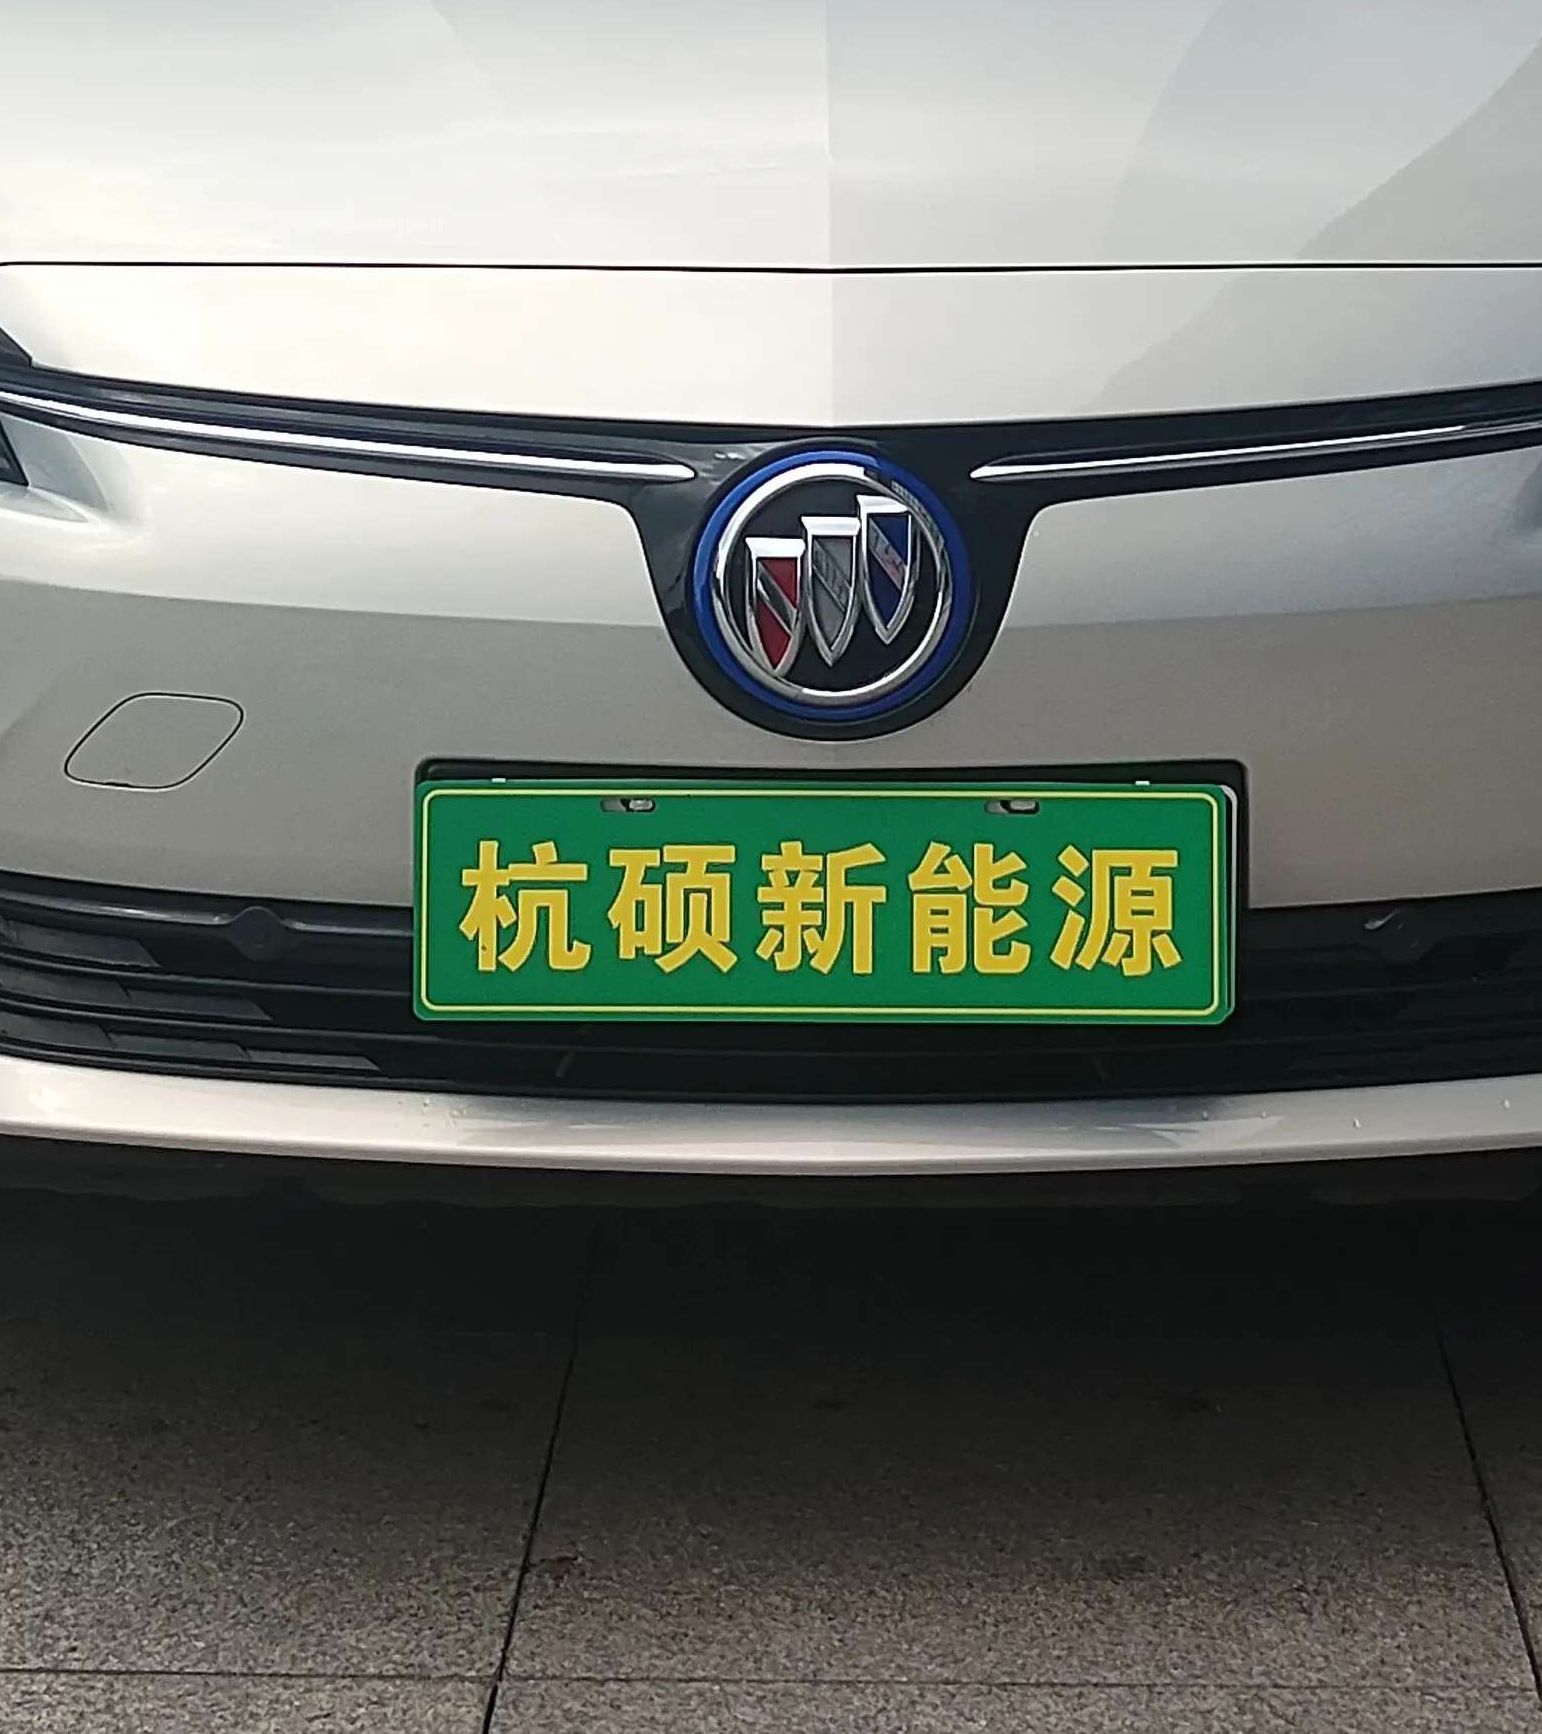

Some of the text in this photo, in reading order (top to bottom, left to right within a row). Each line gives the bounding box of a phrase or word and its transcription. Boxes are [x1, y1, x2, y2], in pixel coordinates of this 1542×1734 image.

[459, 839, 1183, 977] 杭硕新能源
